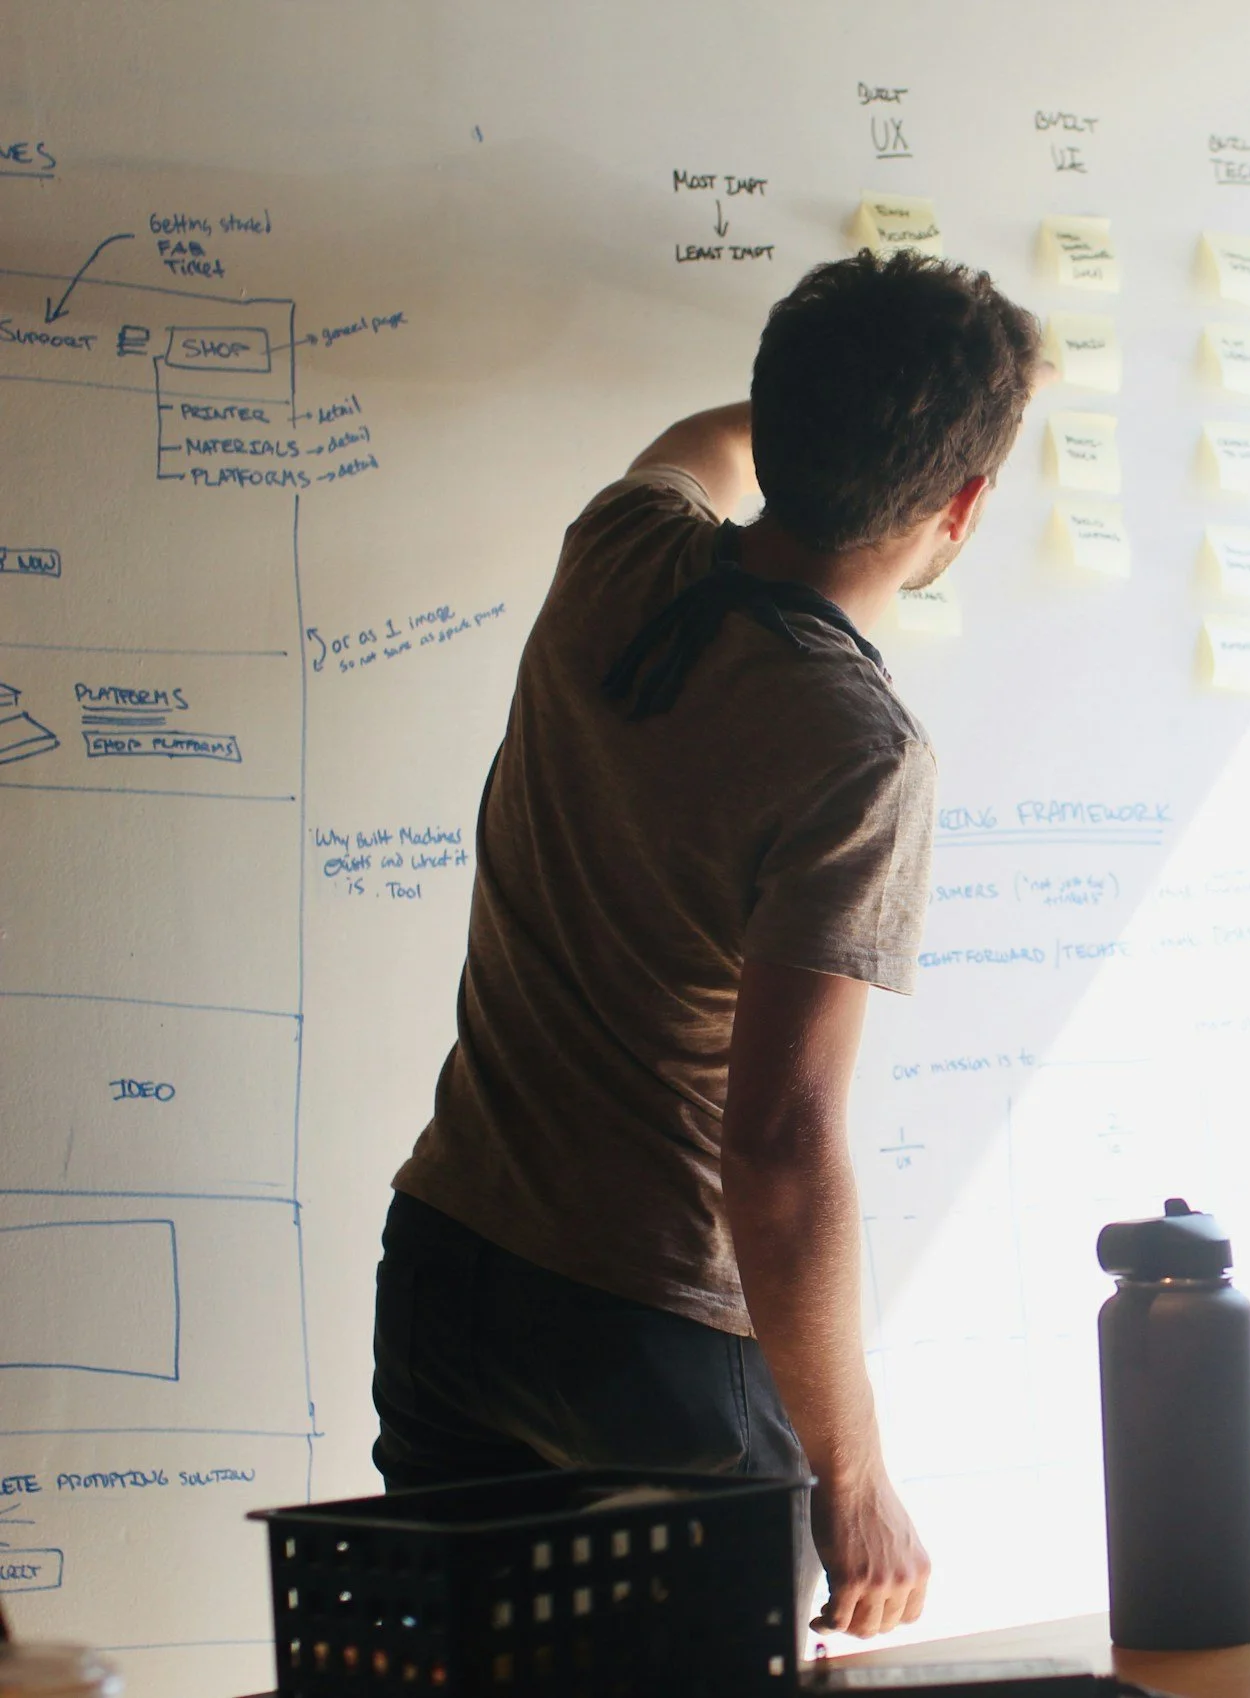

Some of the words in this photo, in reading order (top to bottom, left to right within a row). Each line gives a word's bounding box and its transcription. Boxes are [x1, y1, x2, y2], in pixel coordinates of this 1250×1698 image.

[1035, 110, 1098, 133] BUILT
[871, 116, 908, 152] UX
[1051, 142, 1088, 174] UI
[673, 169, 717, 192] MOST
[724, 175, 768, 196] IMPT
[675, 244, 724, 263] LEAST
[728, 245, 775, 261] IMPT
[182, 338, 252, 358] SHOP
[181, 403, 270, 423] PRINTER
[186, 437, 300, 457] MATERIALS
[190, 467, 311, 488] PLATFORMS
[17, 553, 56, 571] NOW
[332, 634, 350, 654] or
[359, 628, 377, 646] as
[408, 605, 455, 631] image
[75, 682, 189, 710] PLATFORMS
[152, 737, 233, 757] PLATFORMS
[1016, 800, 1173, 825] FRAMEWORK
[315, 828, 350, 850] Why
[399, 825, 462, 846] Machines
[455, 850, 469, 866] it
[346, 877, 365, 895] is
[386, 881, 422, 899] Tool
[930, 1055, 991, 1074] mission
[997, 1053, 1012, 1068] is
[1017, 1047, 1036, 1067] to
[109, 1079, 176, 1102] IDEO
